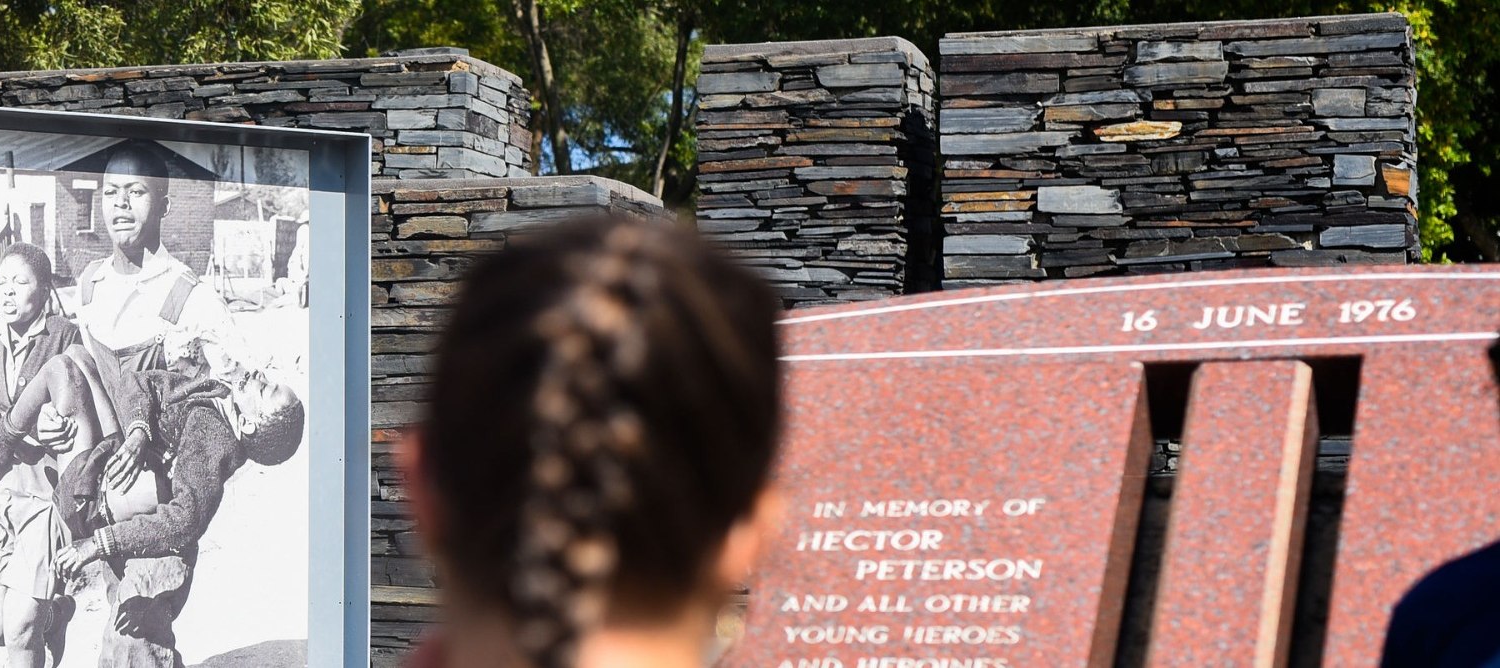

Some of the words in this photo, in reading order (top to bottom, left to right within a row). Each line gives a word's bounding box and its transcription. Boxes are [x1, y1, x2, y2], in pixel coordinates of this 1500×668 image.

[1120, 310, 1158, 332] 16
[1192, 303, 1306, 330] JUNE
[1338, 299, 1417, 323] 1976
[813, 500, 847, 518] IN
[860, 499, 989, 518] MEMORY
[1002, 498, 1046, 517] OF
[796, 529, 943, 551] HECTOR
[855, 558, 1044, 581] PETERSON
[780, 594, 848, 612] AND
[856, 594, 913, 612] ALL
[923, 594, 1031, 613] OTHER
[784, 625, 890, 644] YOUNG
[902, 625, 1021, 645] HEROES
[777, 656, 845, 668] AND
